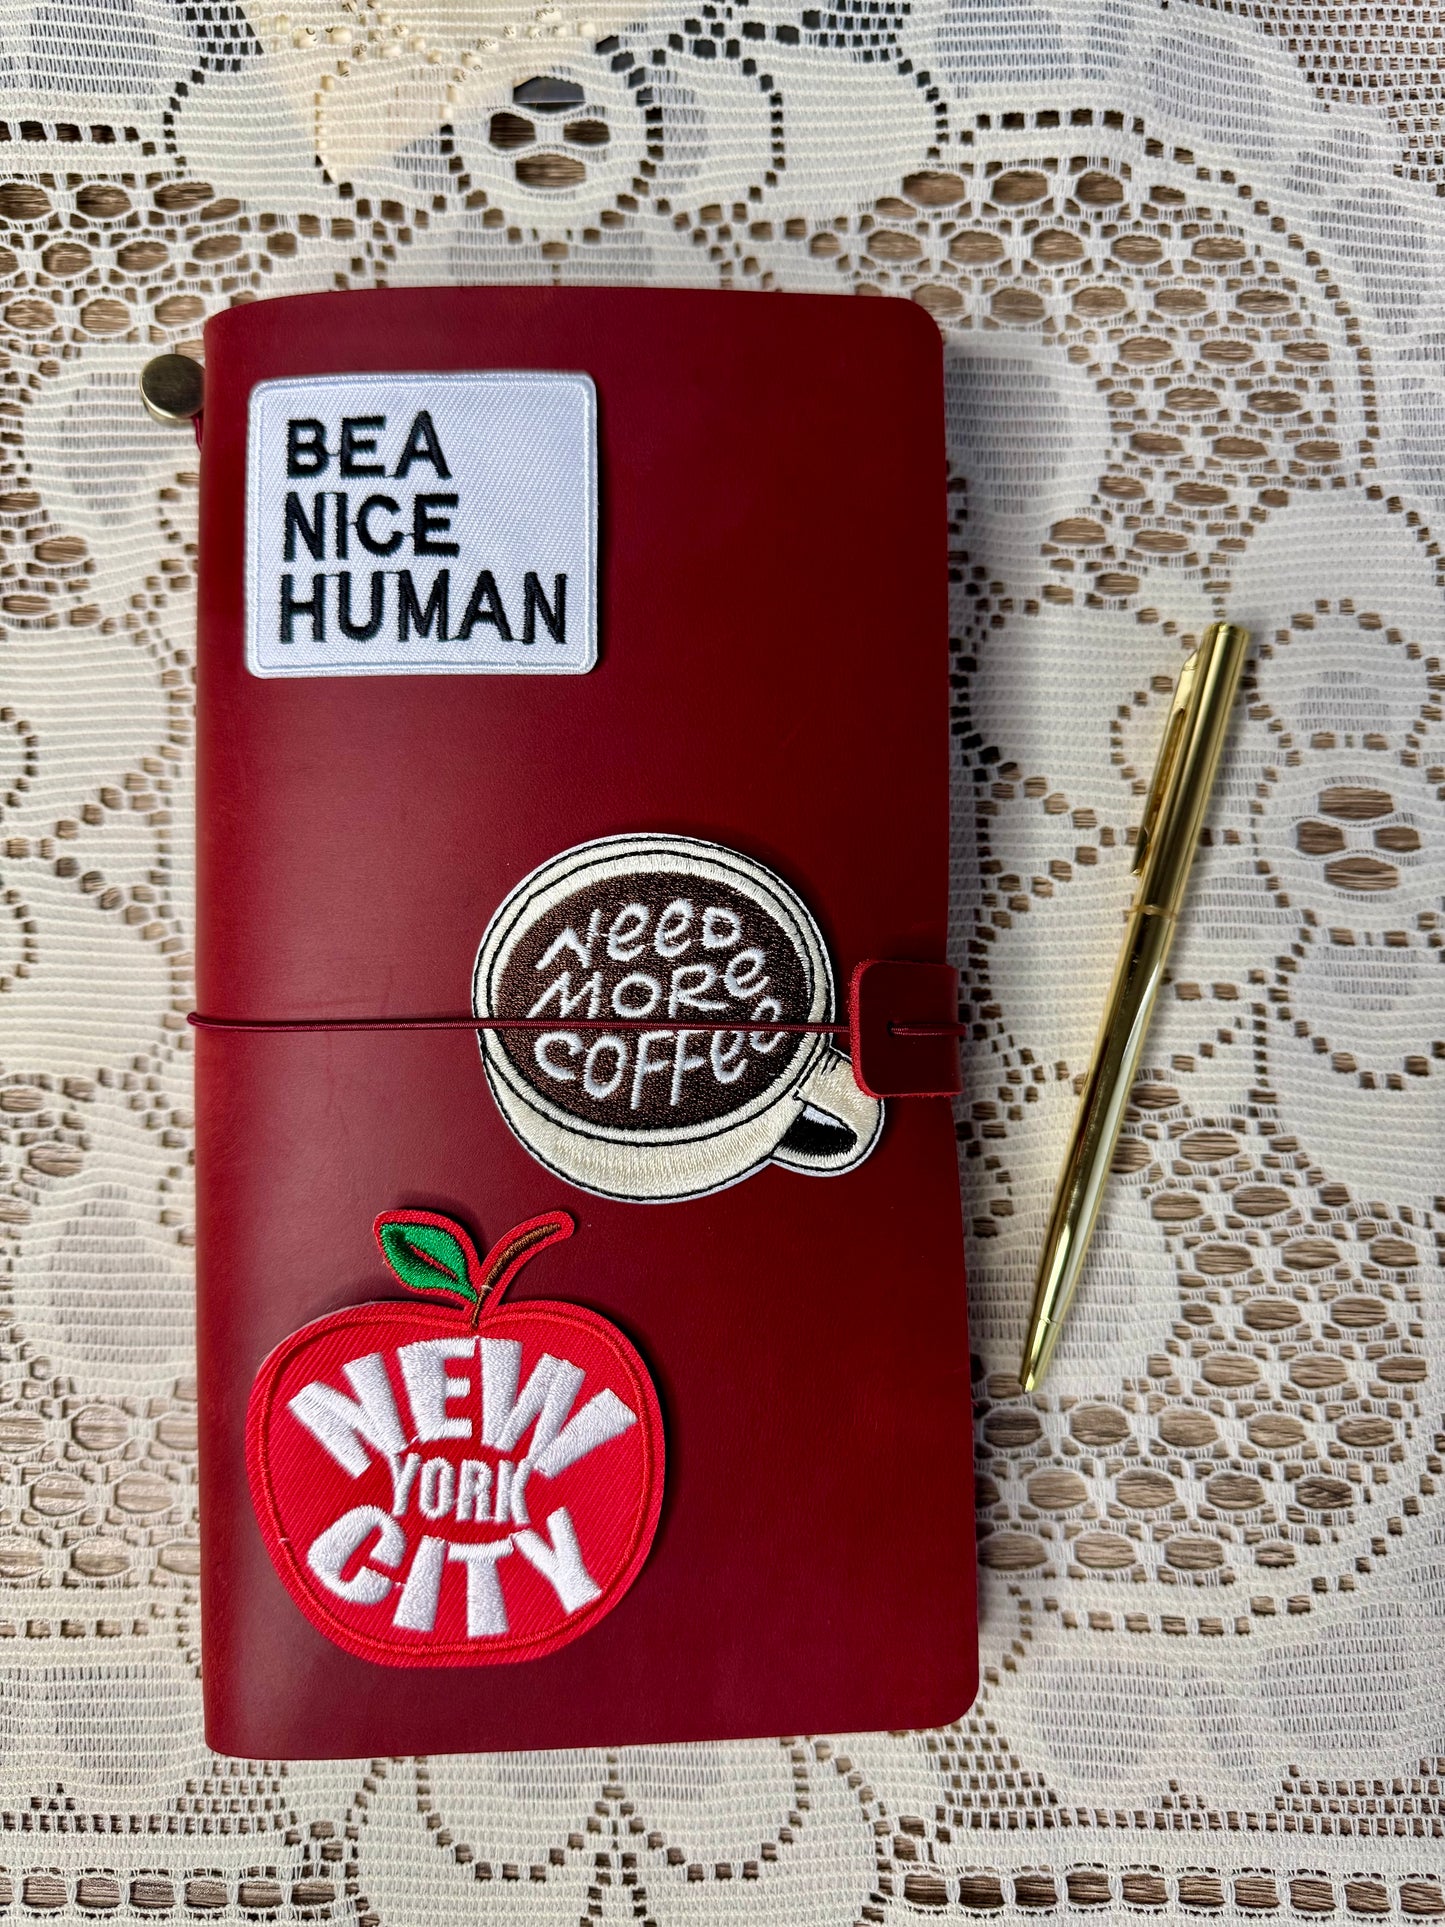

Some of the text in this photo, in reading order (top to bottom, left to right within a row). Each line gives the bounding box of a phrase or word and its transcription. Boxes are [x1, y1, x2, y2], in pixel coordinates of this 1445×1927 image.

[283, 491, 460, 563] NICE
[279, 568, 567, 645] HUMAN
[288, 1335, 638, 1479] NEW
[391, 1450, 533, 1525] YORK
[306, 1504, 602, 1638] CITY
